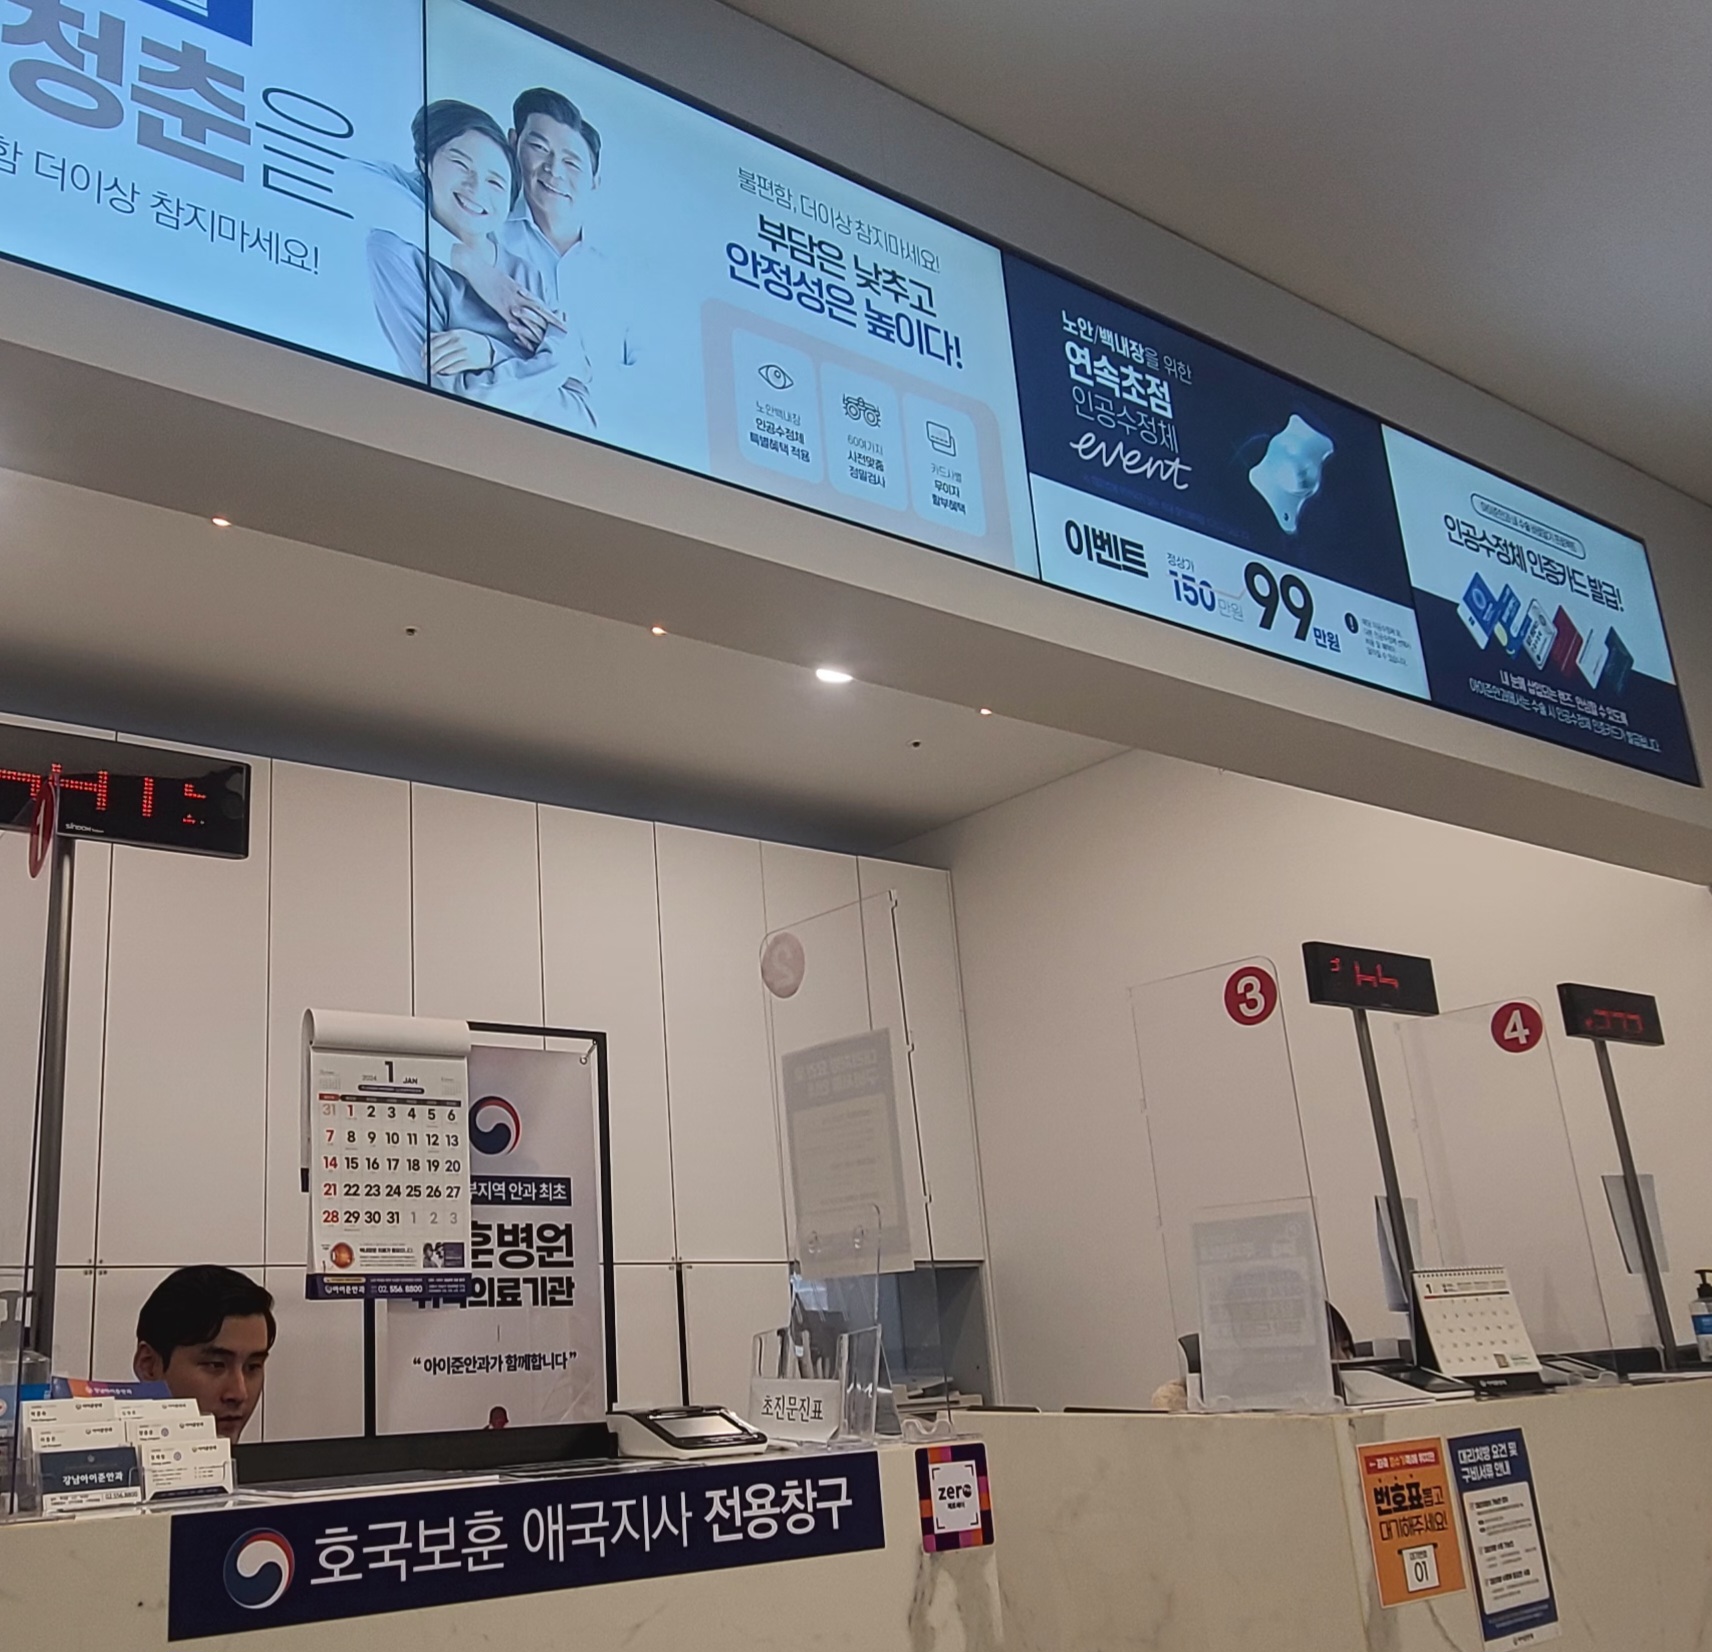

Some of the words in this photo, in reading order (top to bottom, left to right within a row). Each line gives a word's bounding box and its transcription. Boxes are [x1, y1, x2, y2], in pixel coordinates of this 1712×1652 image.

[34, 150, 141, 214] 더이상
[150, 190, 320, 275] 참지마세요!
[738, 166, 798, 214] 불편함,
[799, 194, 853, 232] 더이상
[855, 214, 941, 274] 참지마세요!
[757, 213, 846, 279] 부담은
[853, 252, 937, 318] 낮추고
[724, 240, 858, 328] 안정성은
[864, 298, 964, 370] 높이다!
[1061, 309, 1160, 371] 노안/백내장을
[1162, 353, 1193, 386] 위한
[1064, 340, 1174, 420] 연속초점
[754, 417, 805, 445] 인공수정체
[1071, 385, 1180, 454] 인공수정체
[1069, 431, 1192, 490] event
[848, 465, 886, 488] 정밀검사
[934, 479, 961, 499] 무이자
[1064, 519, 1150, 579] 이벤트
[1166, 551, 1196, 573] 정상가
[1444, 514, 1528, 573] 인공수정체
[1526, 550, 1590, 598] 인증카드
[1587, 574, 1625, 612] 발급!
[1237, 975, 1262, 1017] 3
[1503, 1009, 1530, 1045] 4
[384, 1061, 394, 1083] 1
[402, 1077, 418, 1085] JAN
[323, 1104, 336, 1116] 31
[347, 1104, 353, 1117] 1
[367, 1105, 376, 1118] 2
[388, 1106, 396, 1119] 3
[407, 1107, 416, 1120] 4
[428, 1109, 435, 1121] 5
[447, 1109, 456, 1121] 6
[326, 1129, 334, 1142] 7
[347, 1130, 356, 1143] 8
[368, 1131, 376, 1144] 9
[385, 1132, 399, 1144] 10
[407, 1133, 418, 1145] 11
[426, 1133, 439, 1146] 12
[446, 1134, 459, 1147] 13
[323, 1156, 337, 1169] 14
[344, 1157, 359, 1170] 15
[366, 1157, 379, 1170] 16
[386, 1158, 400, 1171] 17
[407, 1158, 420, 1171] 18
[427, 1159, 440, 1172] 19
[445, 1159, 460, 1172] 20
[323, 1183, 337, 1196] 21
[343, 1184, 360, 1196] 22
[364, 1184, 381, 1197] 23
[385, 1184, 401, 1197] 24
[405, 1185, 421, 1198] 25
[425, 1186, 441, 1198] 26
[446, 1186, 460, 1199] 27
[508, 1181, 537, 1200] 안과
[539, 1181, 568, 1201] 최초
[322, 1210, 339, 1223] 28
[343, 1210, 360, 1224] 29
[364, 1211, 381, 1224] 30
[386, 1211, 400, 1224] 31
[411, 1211, 416, 1224] 1
[430, 1212, 438, 1224] 2
[451, 1212, 458, 1225] 3
[761, 1394, 824, 1422] 초진문진표
[1457, 1443, 1491, 1465] 대리처방
[1491, 1443, 1508, 1460] 요건
[1508, 1441, 1518, 1457] 및
[62, 1471, 124, 1487] 강남아이준안과
[1461, 1463, 1494, 1484] 구비서류
[1494, 1460, 1512, 1477] 안내
[938, 1483, 973, 1502] zero
[309, 1509, 508, 1587] 호국보훈
[522, 1490, 693, 1563] 애국지사
[702, 1476, 853, 1545] 전용창구
[1413, 1560, 1429, 1583] 01
